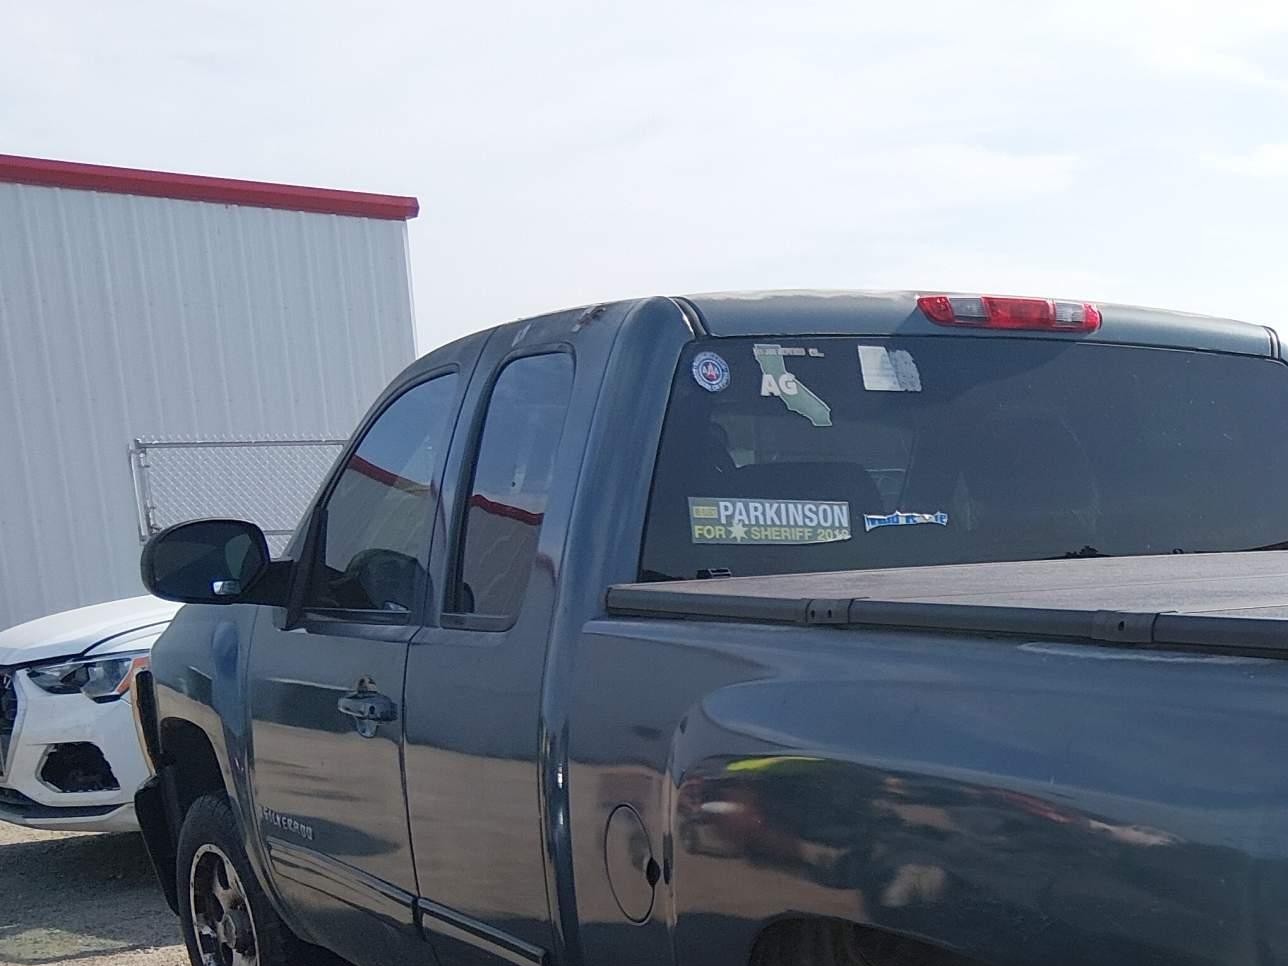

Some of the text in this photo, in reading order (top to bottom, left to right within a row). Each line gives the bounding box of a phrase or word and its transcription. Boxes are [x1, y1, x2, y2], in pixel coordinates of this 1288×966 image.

[761, 372, 798, 396] AG
[718, 501, 849, 528] PARKINSON
[694, 525, 726, 539] FOR
[751, 527, 813, 541] SHERIFF
